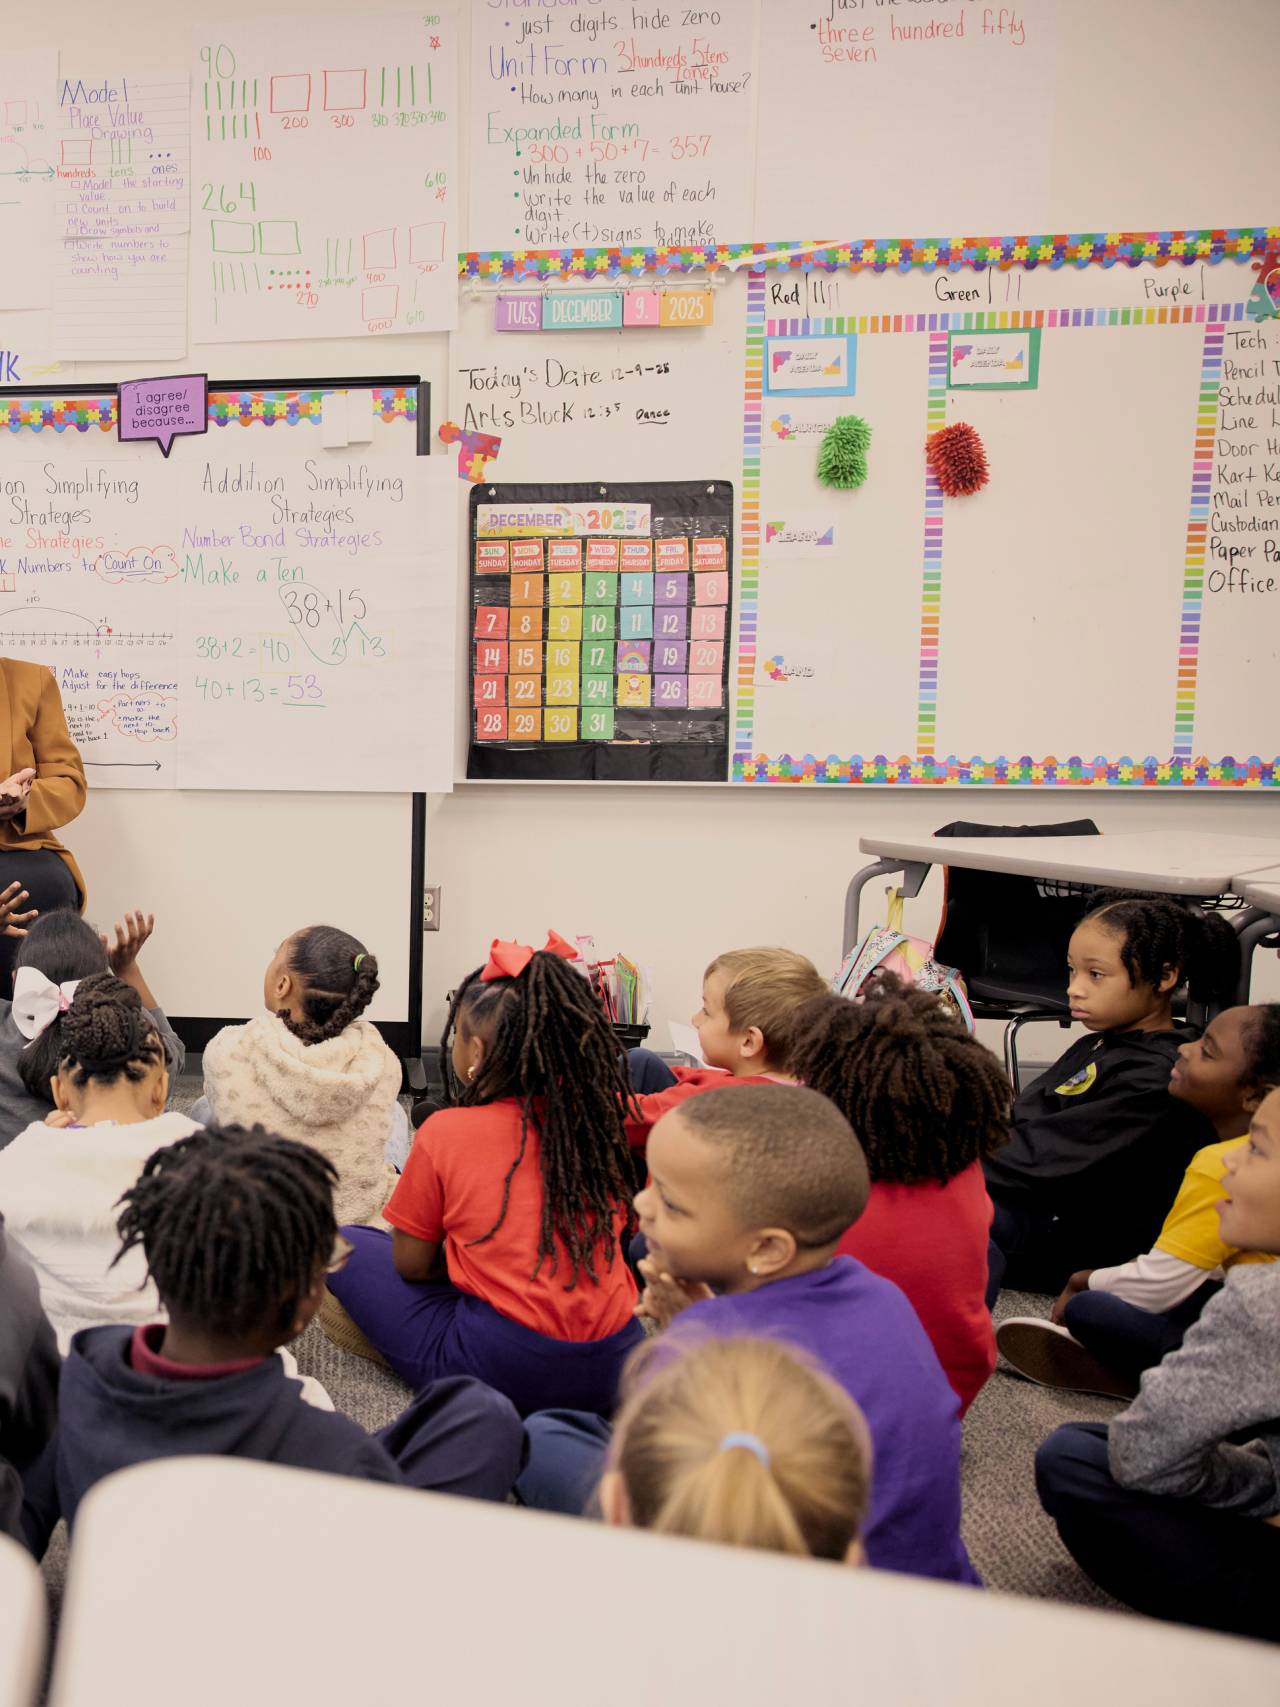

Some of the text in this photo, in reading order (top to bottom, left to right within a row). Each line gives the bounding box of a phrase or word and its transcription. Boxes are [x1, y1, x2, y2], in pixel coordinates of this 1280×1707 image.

[516, 7, 722, 44] just digits hide zero
[817, 8, 1025, 45] three hundred fifty
[200, 44, 236, 80] 90
[488, 42, 607, 81] Unit Form
[61, 78, 128, 106] Model
[520, 81, 554, 104] How
[557, 87, 600, 109] many
[611, 84, 623, 98] in
[631, 77, 664, 98] each
[710, 72, 752, 95] house?
[70, 106, 99, 128] Place
[108, 103, 144, 127] Value
[280, 117, 309, 130] 200
[329, 116, 355, 128] 300
[91, 127, 154, 144] Drawing
[487, 110, 640, 152] Expanded Form
[57, 165, 96, 178] hundreds
[110, 167, 134, 178] tens
[151, 164, 178, 175] ones
[584, 162, 606, 184] the
[614, 168, 646, 184] zero
[201, 180, 256, 213] 264
[584, 187, 606, 205] the
[619, 185, 656, 204] value
[663, 181, 677, 202] of
[682, 180, 716, 201] each
[524, 208, 563, 229] digit
[771, 283, 801, 306] Red
[935, 276, 981, 302] Green
[1144, 277, 1192, 302] Purple
[551, 298, 612, 322] DECEMBER
[669, 296, 705, 320] 2025
[1226, 329, 1266, 350] Tech
[458, 365, 539, 398] Today's
[545, 358, 603, 388] Date
[1224, 360, 1264, 381] Pencil
[146, 389, 187, 404] agree/
[135, 403, 190, 416] disagree
[463, 402, 515, 431] Arts
[520, 401, 575, 424] Block
[635, 407, 670, 419] Dance
[1221, 409, 1258, 431] Line
[132, 416, 194, 429] because...
[1218, 438, 1260, 457] Door
[44, 462, 139, 504] Simplifying
[203, 459, 404, 503] Addition Simplifying
[1217, 464, 1257, 485] Kart
[1213, 489, 1248, 509] Mail
[271, 494, 355, 533] Strategies
[490, 510, 638, 530] DECEMBER 2025
[1211, 512, 1279, 532] Custodian
[182, 525, 383, 556] Number Bond Strategies
[1210, 536, 1257, 567] Paper
[18, 555, 162, 574] Numbers to Count On
[184, 553, 305, 585] Make a Ten
[478, 559, 506, 568] SUNDAY
[522, 580, 529, 597] 1
[595, 579, 607, 597] 3
[665, 580, 677, 598] 5
[591, 614, 607, 632] 10
[63, 668, 140, 681] Make easy hops
[61, 679, 179, 694] Adjust for the difference
[587, 679, 608, 699] 24
[589, 712, 607, 731] 31
